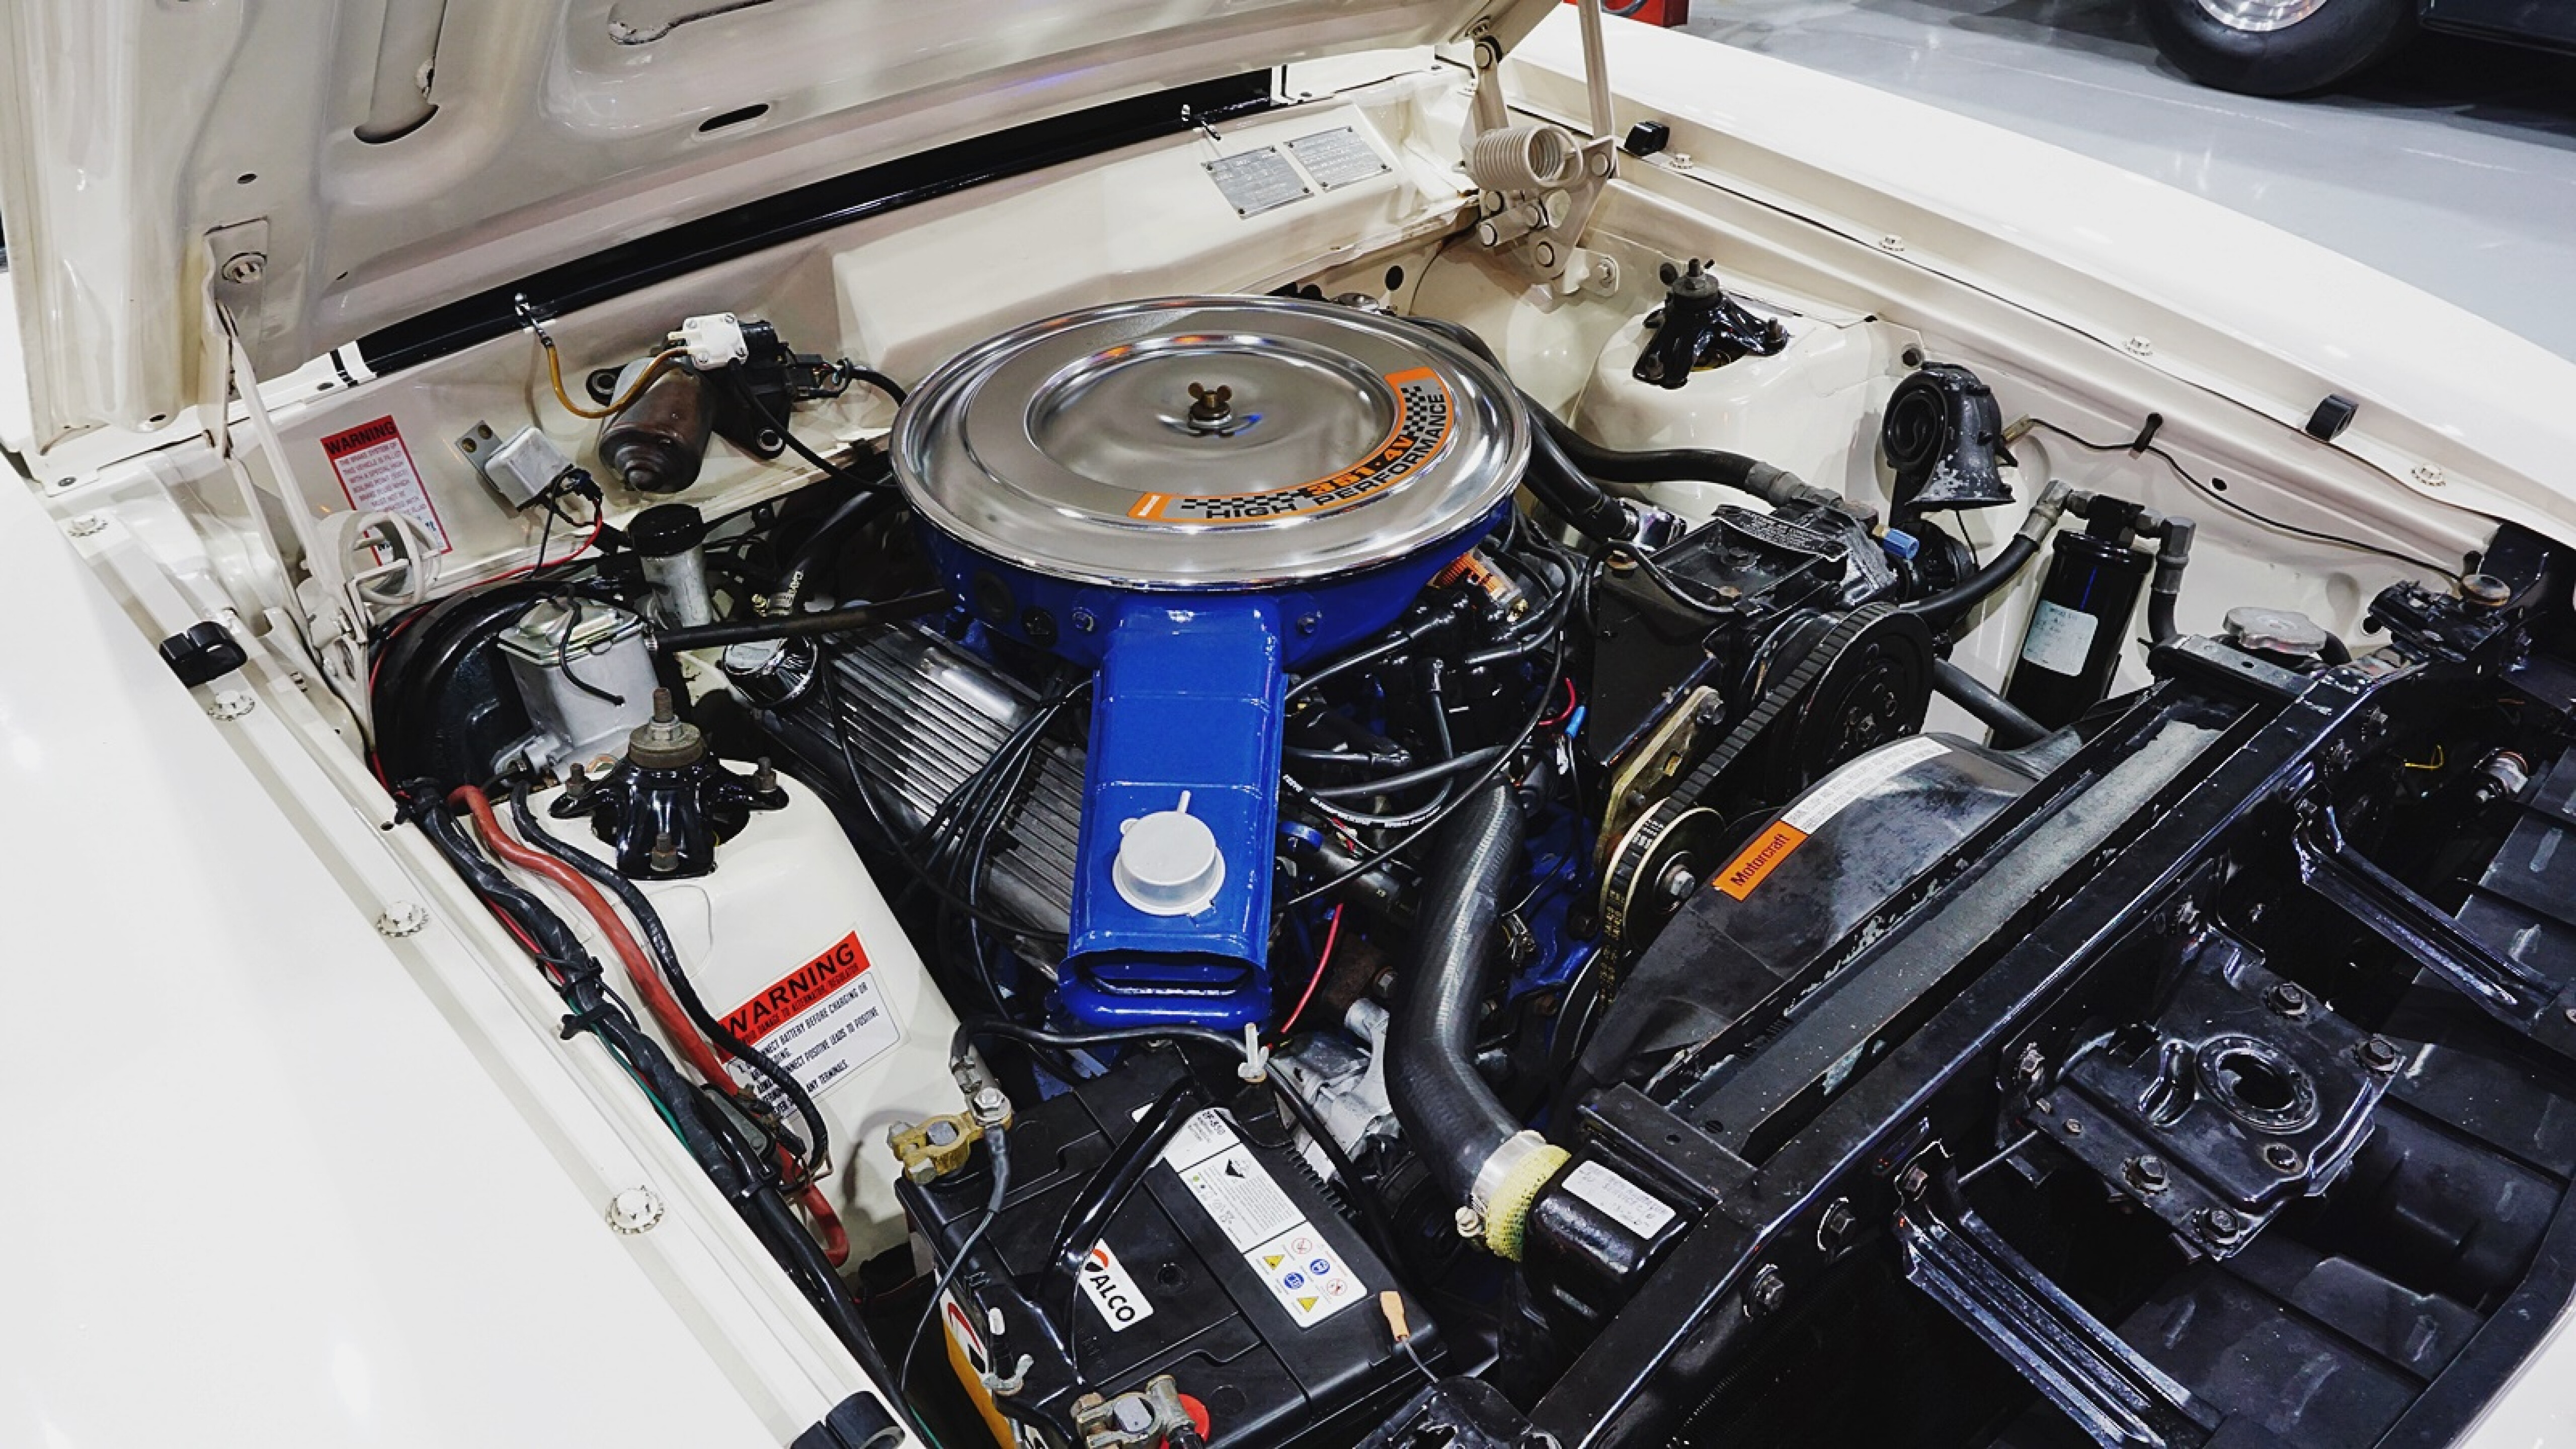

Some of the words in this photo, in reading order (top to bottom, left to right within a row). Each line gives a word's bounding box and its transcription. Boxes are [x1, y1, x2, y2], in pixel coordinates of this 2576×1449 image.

[325, 421, 396, 454] WARNING
[1206, 503, 1298, 519] HIGH
[1313, 394, 1447, 506] PERFORMANCE
[1730, 832, 1791, 888] Motorcraft
[721, 943, 855, 1035] WARNING
[779, 1022, 806, 1045] BATTERY
[804, 1008, 829, 1029] BEFORE
[829, 988, 859, 1014] CHARGING
[858, 982, 868, 994] OR
[804, 1038, 830, 1062] POSITIVE
[830, 1028, 847, 1045] LEADS
[846, 1021, 856, 1033] TO
[854, 1007, 879, 1029] POSITIVE
[807, 1078, 819, 1093] ANY
